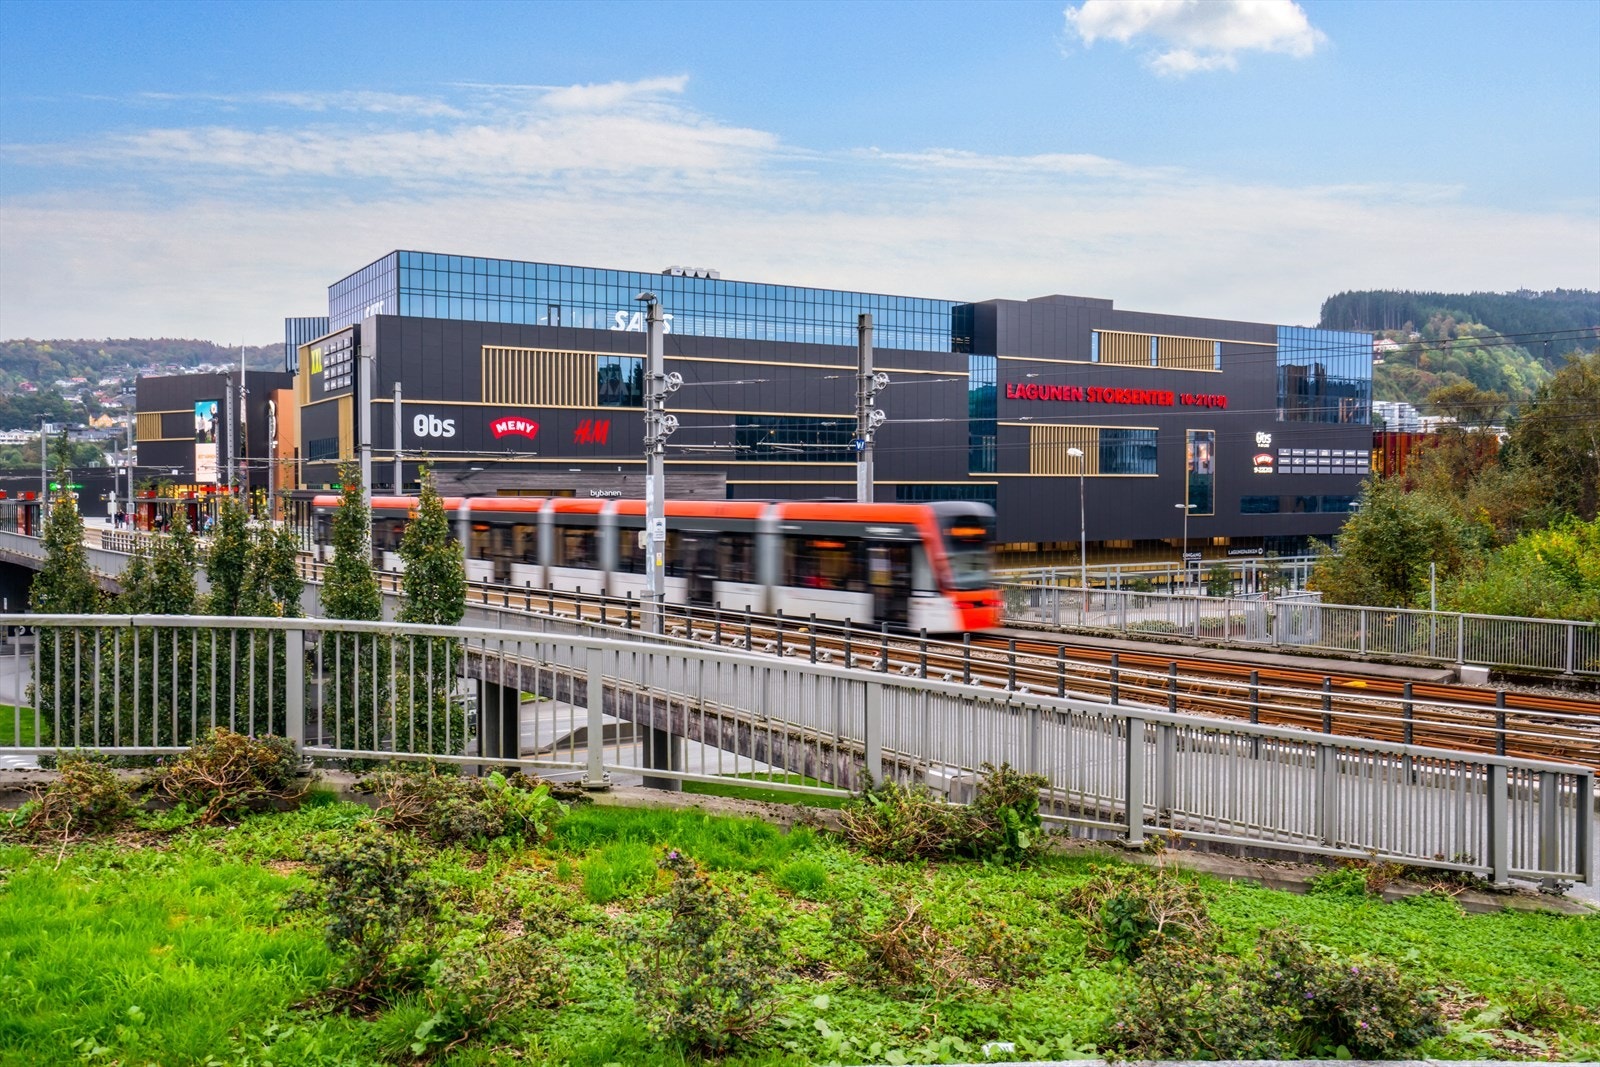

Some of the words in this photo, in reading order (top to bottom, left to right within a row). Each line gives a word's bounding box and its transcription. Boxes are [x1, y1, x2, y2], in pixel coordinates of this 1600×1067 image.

[610, 310, 674, 334] SAS
[1006, 382, 1083, 401] LAGUNEN
[1086, 386, 1175, 406] STORSENTER
[413, 414, 455, 437] Obs
[495, 420, 535, 434] MENY
[573, 418, 611, 445] H&M
[590, 489, 622, 498] bybanen
